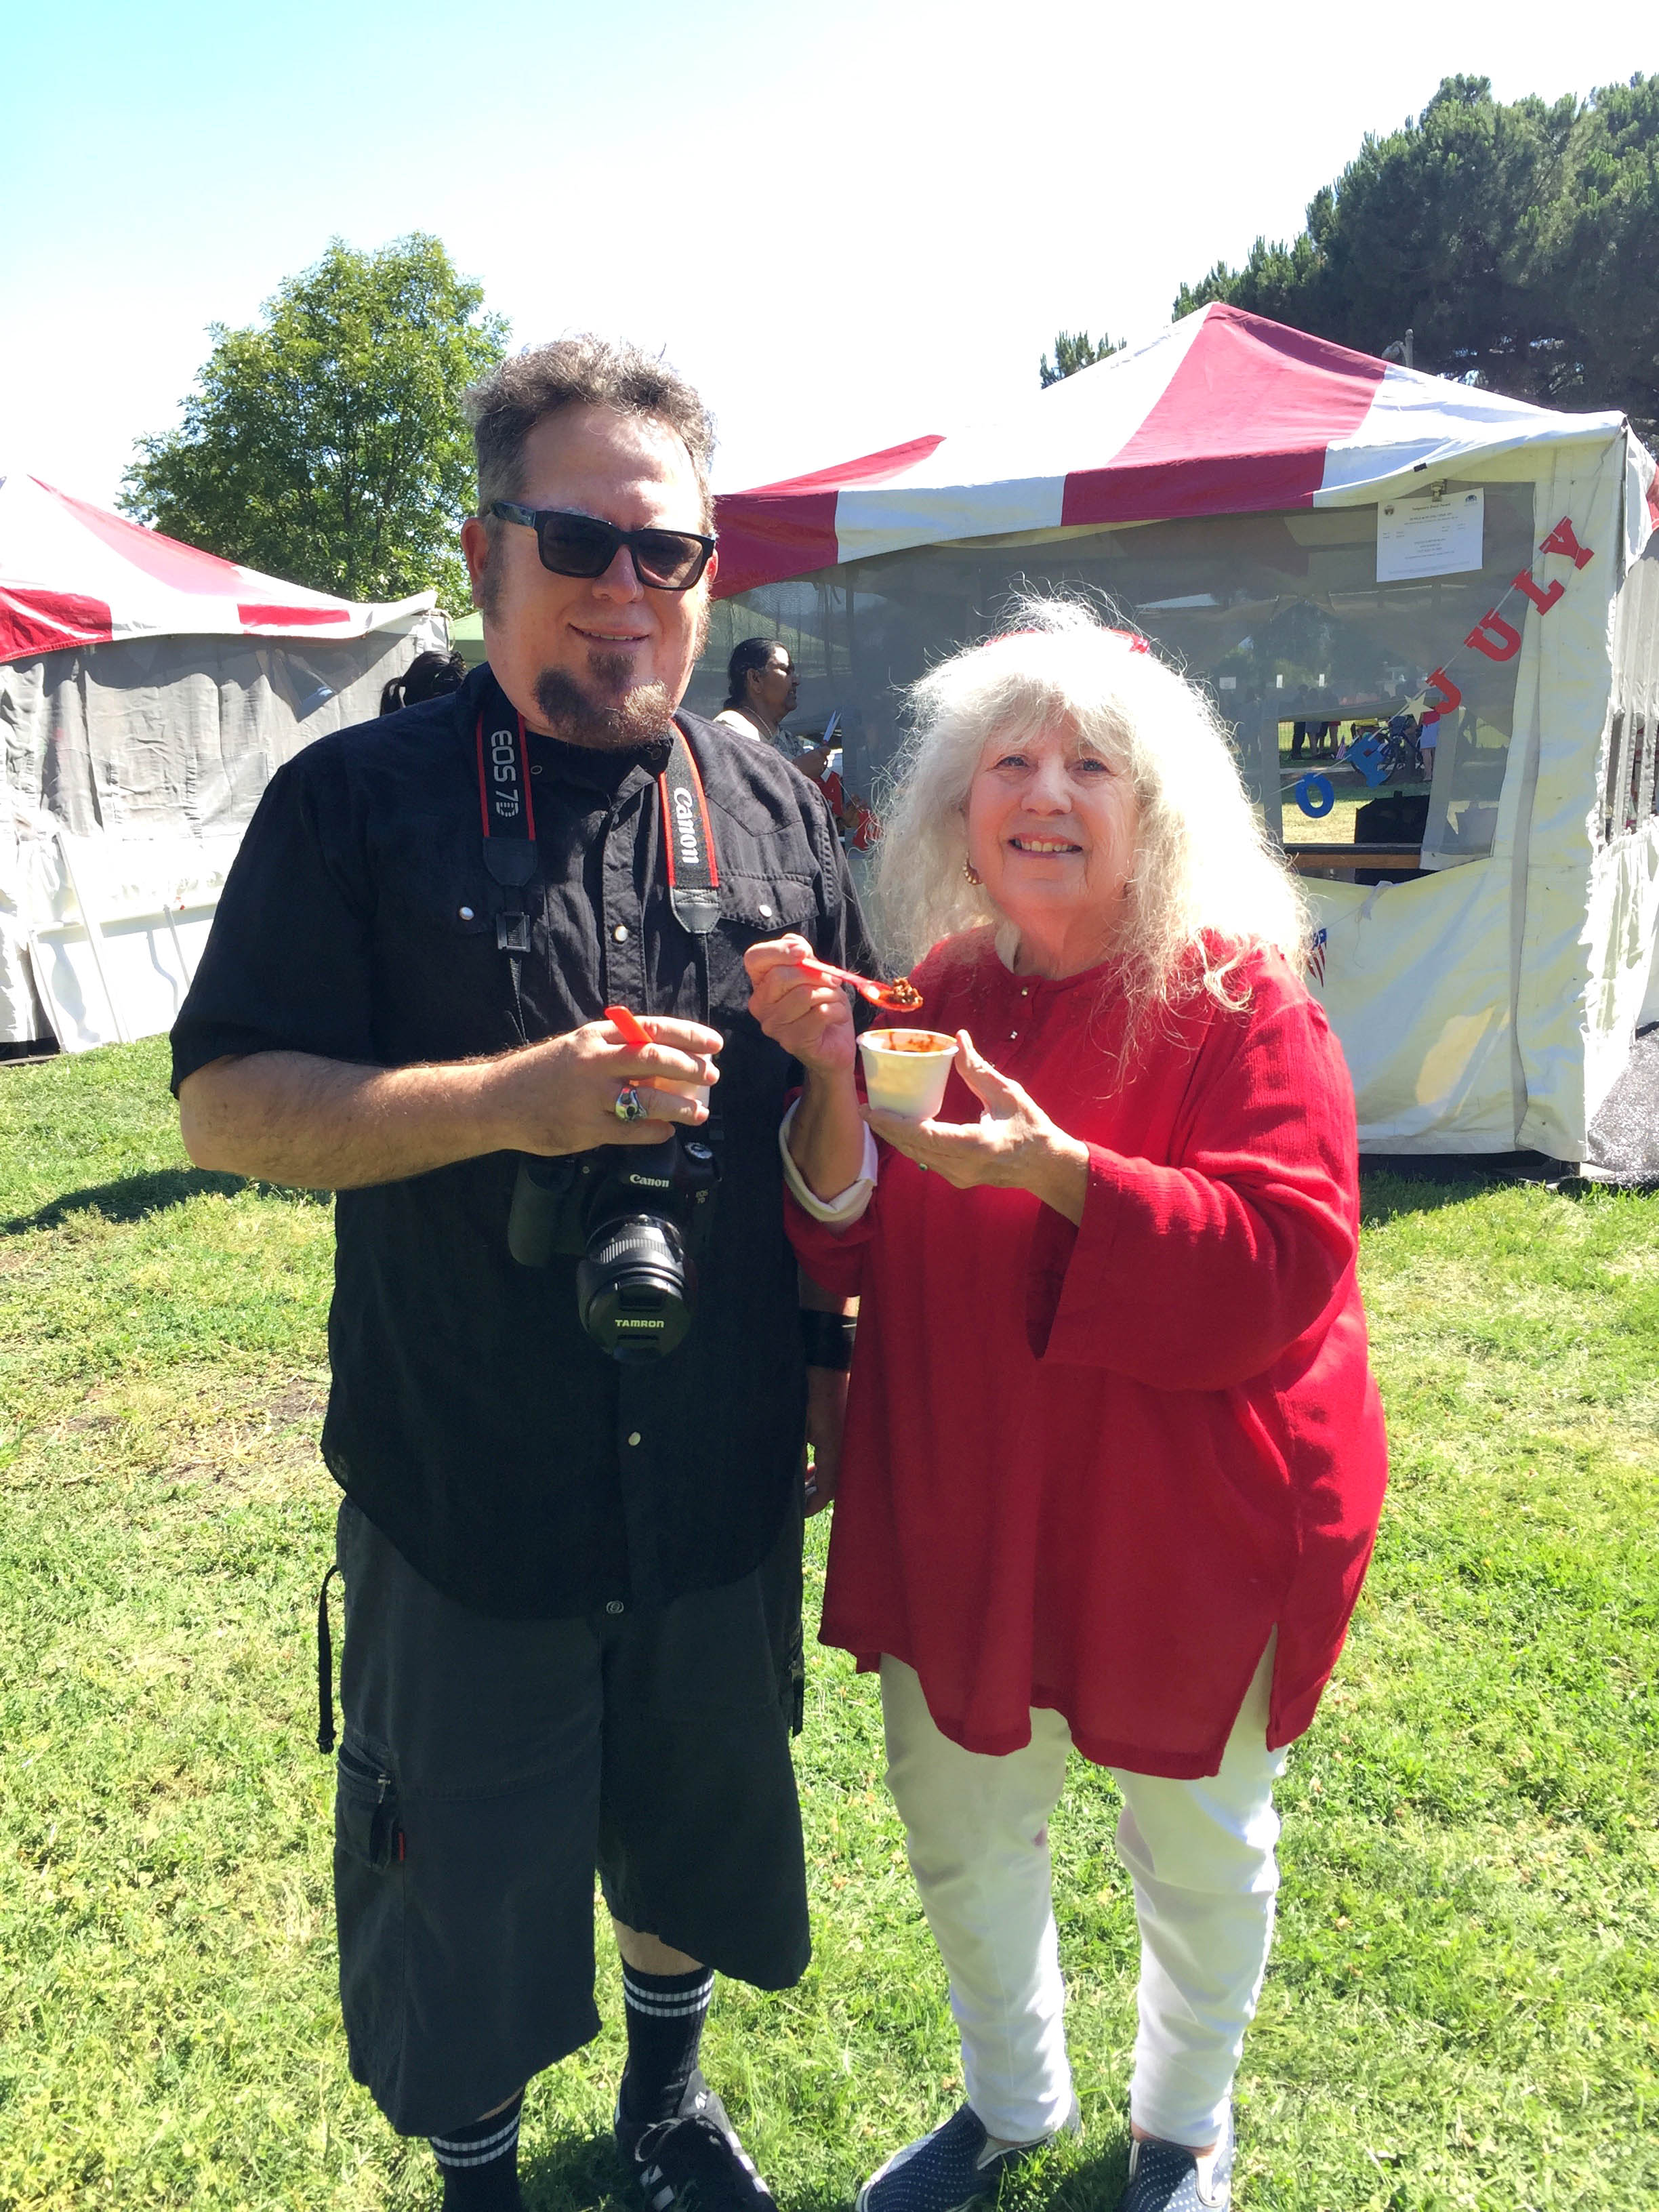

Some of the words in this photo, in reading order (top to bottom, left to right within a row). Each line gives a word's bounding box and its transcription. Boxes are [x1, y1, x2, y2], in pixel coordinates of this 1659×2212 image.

[1295, 732, 1388, 819] OF
[1426, 516, 1595, 715] JULY
[491, 730, 516, 782] EOS
[495, 789, 519, 817] 7D
[674, 787, 699, 863] Canon
[630, 1174, 670, 1187] Canon
[615, 1319, 664, 1328] TAMRON
